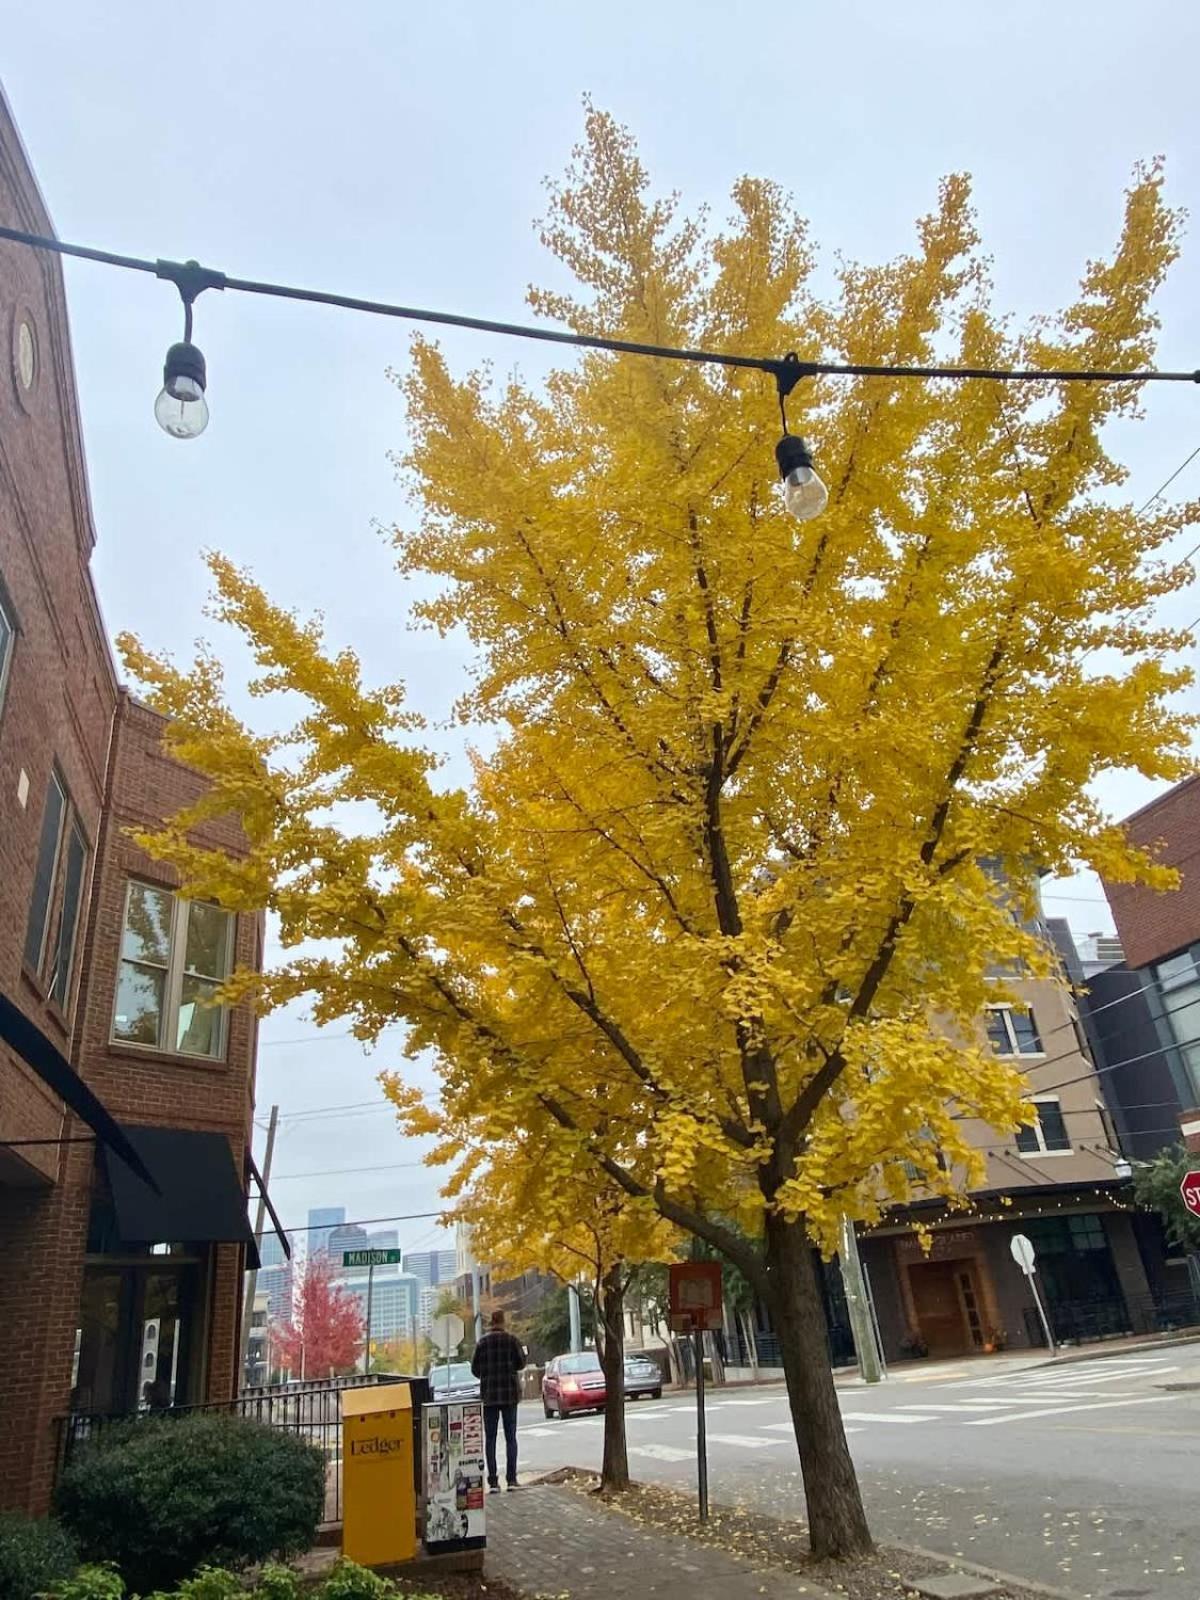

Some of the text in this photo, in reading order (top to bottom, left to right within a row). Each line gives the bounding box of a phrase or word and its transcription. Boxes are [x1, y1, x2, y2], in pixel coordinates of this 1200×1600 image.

[349, 1251, 387, 1265] MADISON
[463, 1415, 481, 1455] SCENE
[351, 1437, 404, 1456] Ledger
